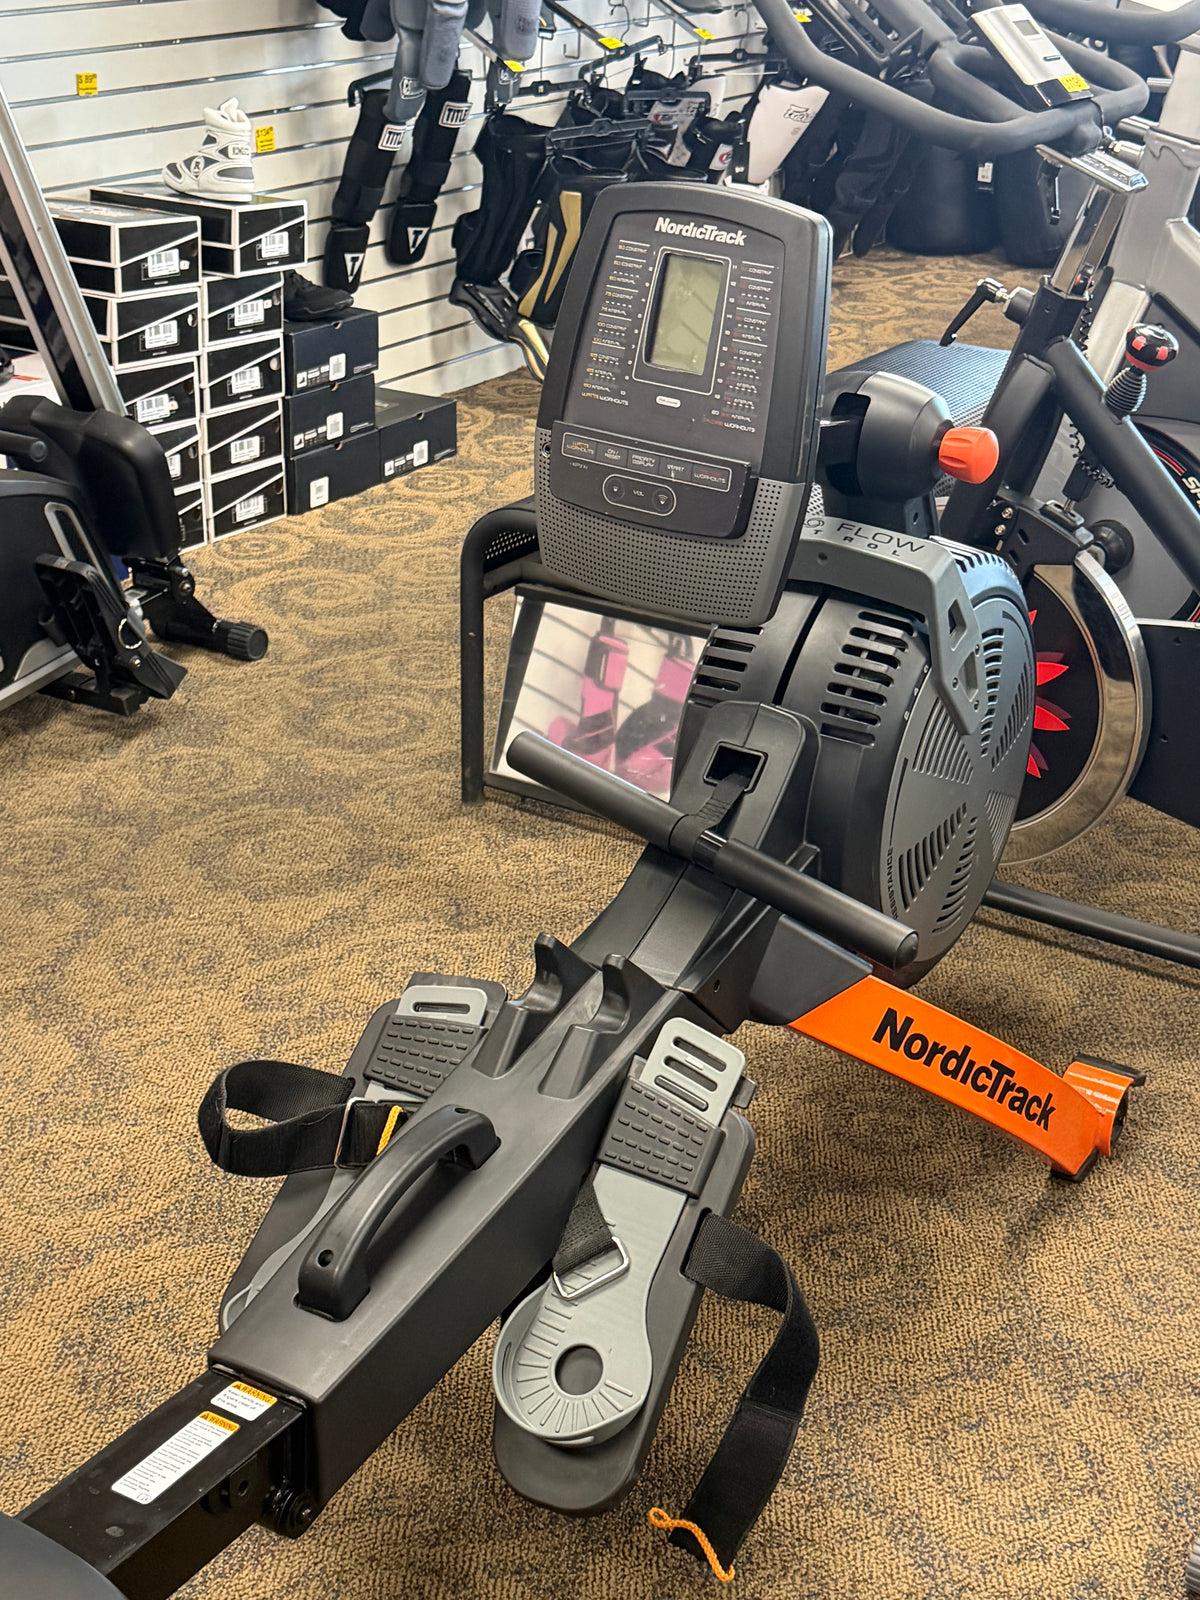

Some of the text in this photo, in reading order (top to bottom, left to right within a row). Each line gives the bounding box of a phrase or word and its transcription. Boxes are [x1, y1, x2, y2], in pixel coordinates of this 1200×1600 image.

[654, 216, 747, 246] NordicTrack
[836, 522, 925, 552] FLOW
[872, 1007, 1056, 1132] NordicTrack
